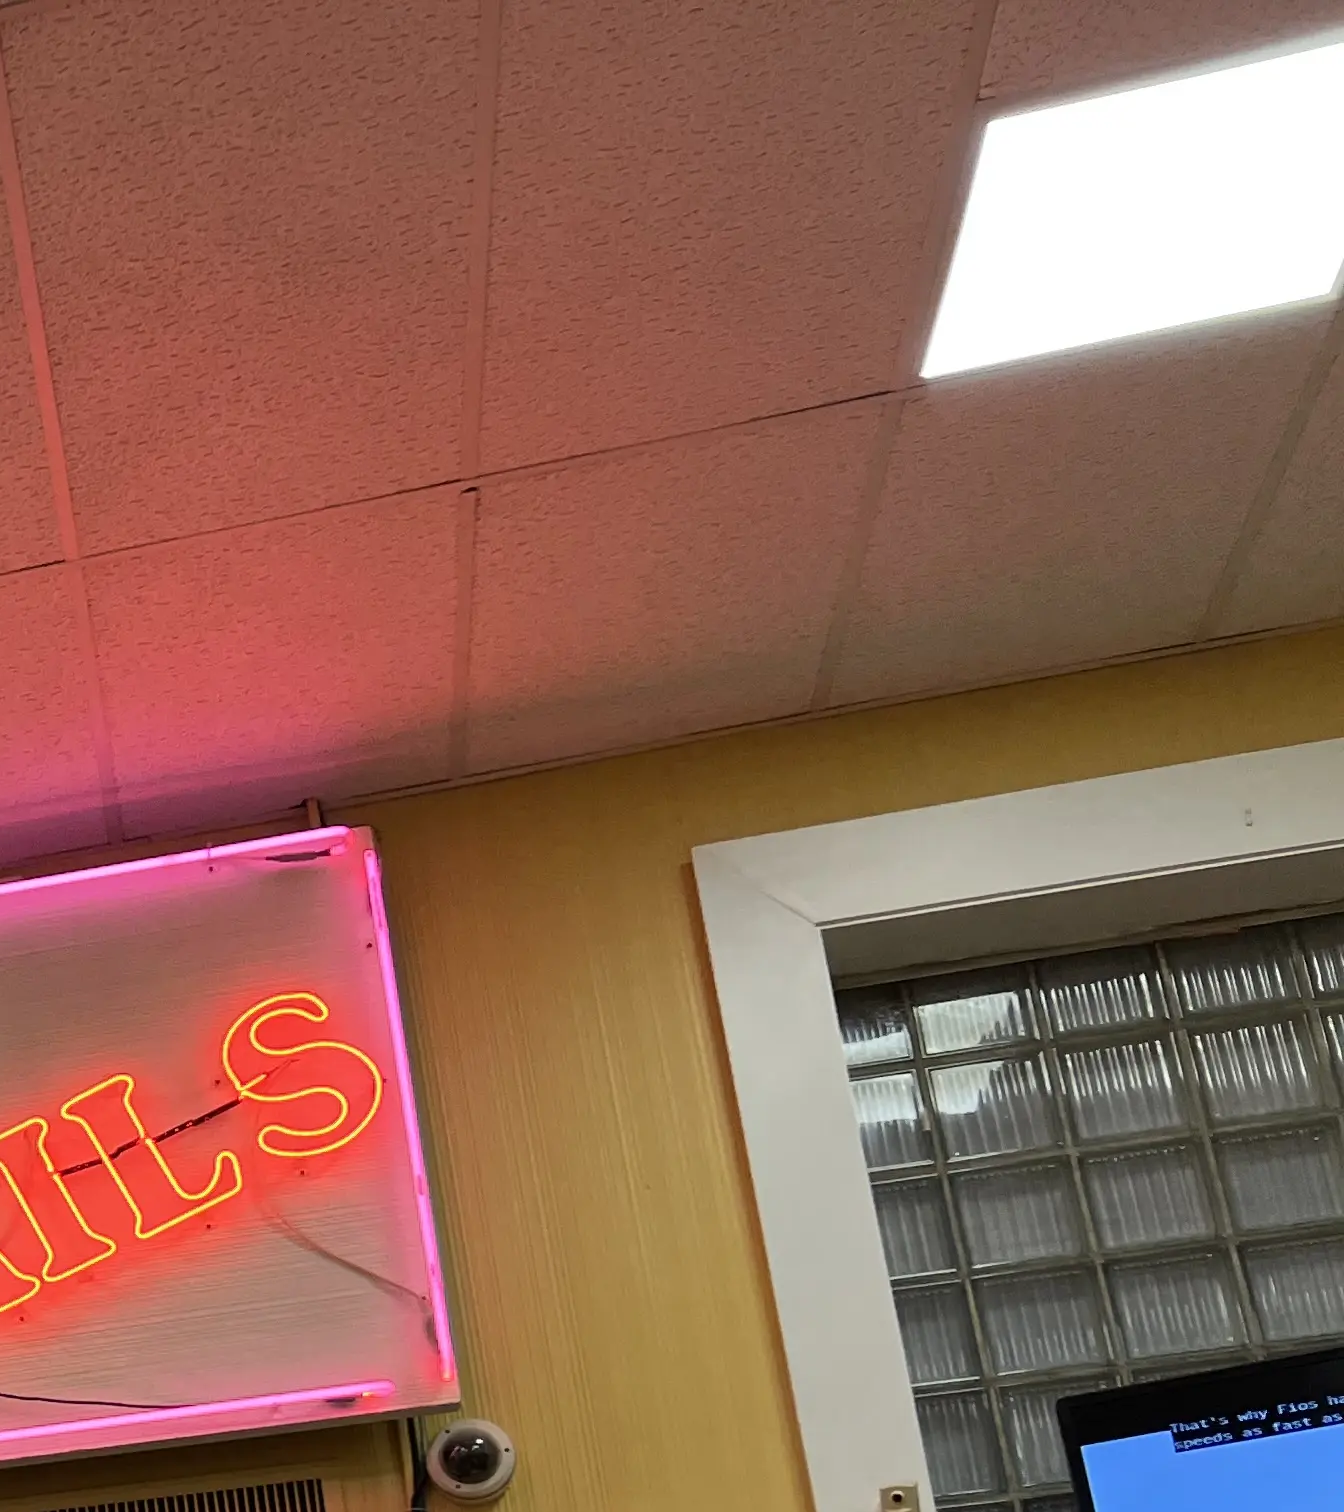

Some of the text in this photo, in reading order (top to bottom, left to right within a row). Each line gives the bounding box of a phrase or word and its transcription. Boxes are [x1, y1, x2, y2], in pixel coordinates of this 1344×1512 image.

[1169, 1416, 1229, 1433] That's
[1236, 1408, 1268, 1422] why
[1276, 1399, 1319, 1415] Fios
[1174, 1412, 1343, 1450] speeds as fast as
